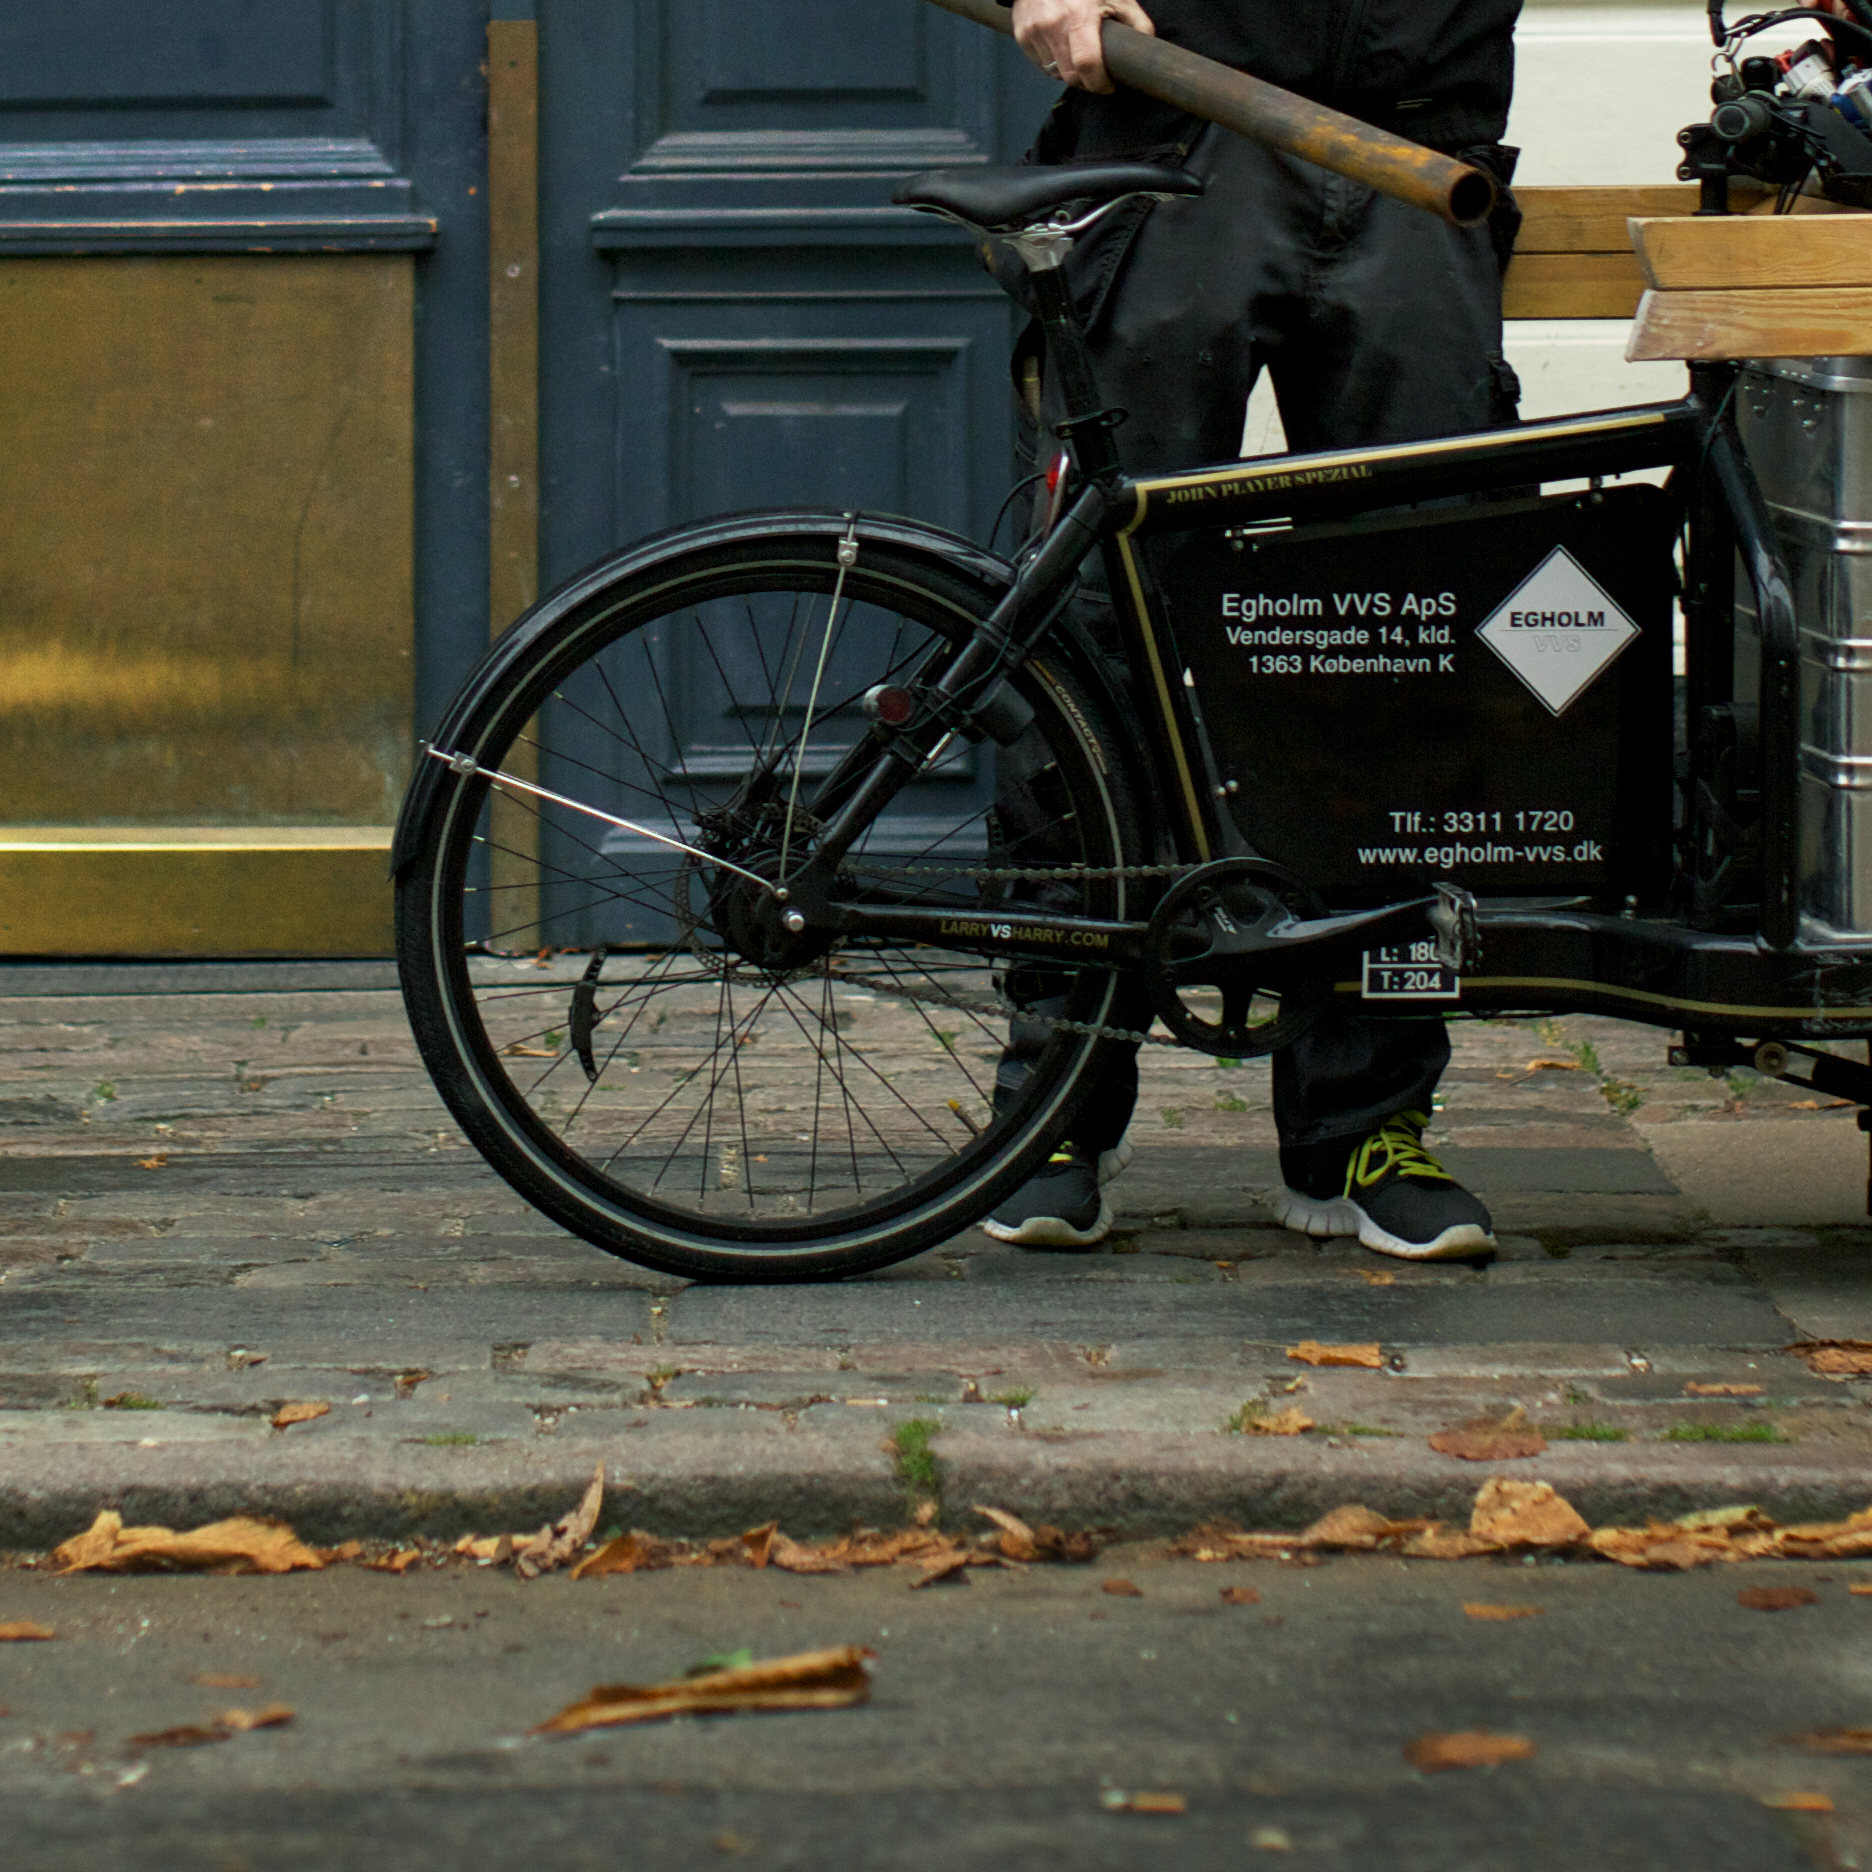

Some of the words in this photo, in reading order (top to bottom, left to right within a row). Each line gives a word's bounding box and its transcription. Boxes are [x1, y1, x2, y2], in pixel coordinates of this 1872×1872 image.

[1165, 485, 1221, 504] JOHN
[1221, 475, 1294, 497] PLAYER
[1293, 464, 1373, 486] SPEZIAL
[1222, 593, 1323, 623] Egholm
[1332, 593, 1392, 616] VVS
[1400, 592, 1456, 621] ApS
[1510, 610, 1605, 628] EGHOLM
[1225, 625, 1370, 650] Vendersgade
[1377, 625, 1410, 647] 14,
[1419, 625, 1456, 644] kld.
[1533, 634, 1582, 653] VVS
[1249, 654, 1303, 674] 1363
[1309, 653, 1431, 674] København
[1438, 653, 1454, 672] K
[1389, 811, 1435, 833] Tlf.:
[1443, 811, 1501, 833] 3311
[1514, 810, 1574, 832] 1720
[1357, 840, 1602, 869] www.egholm-vvs.dk
